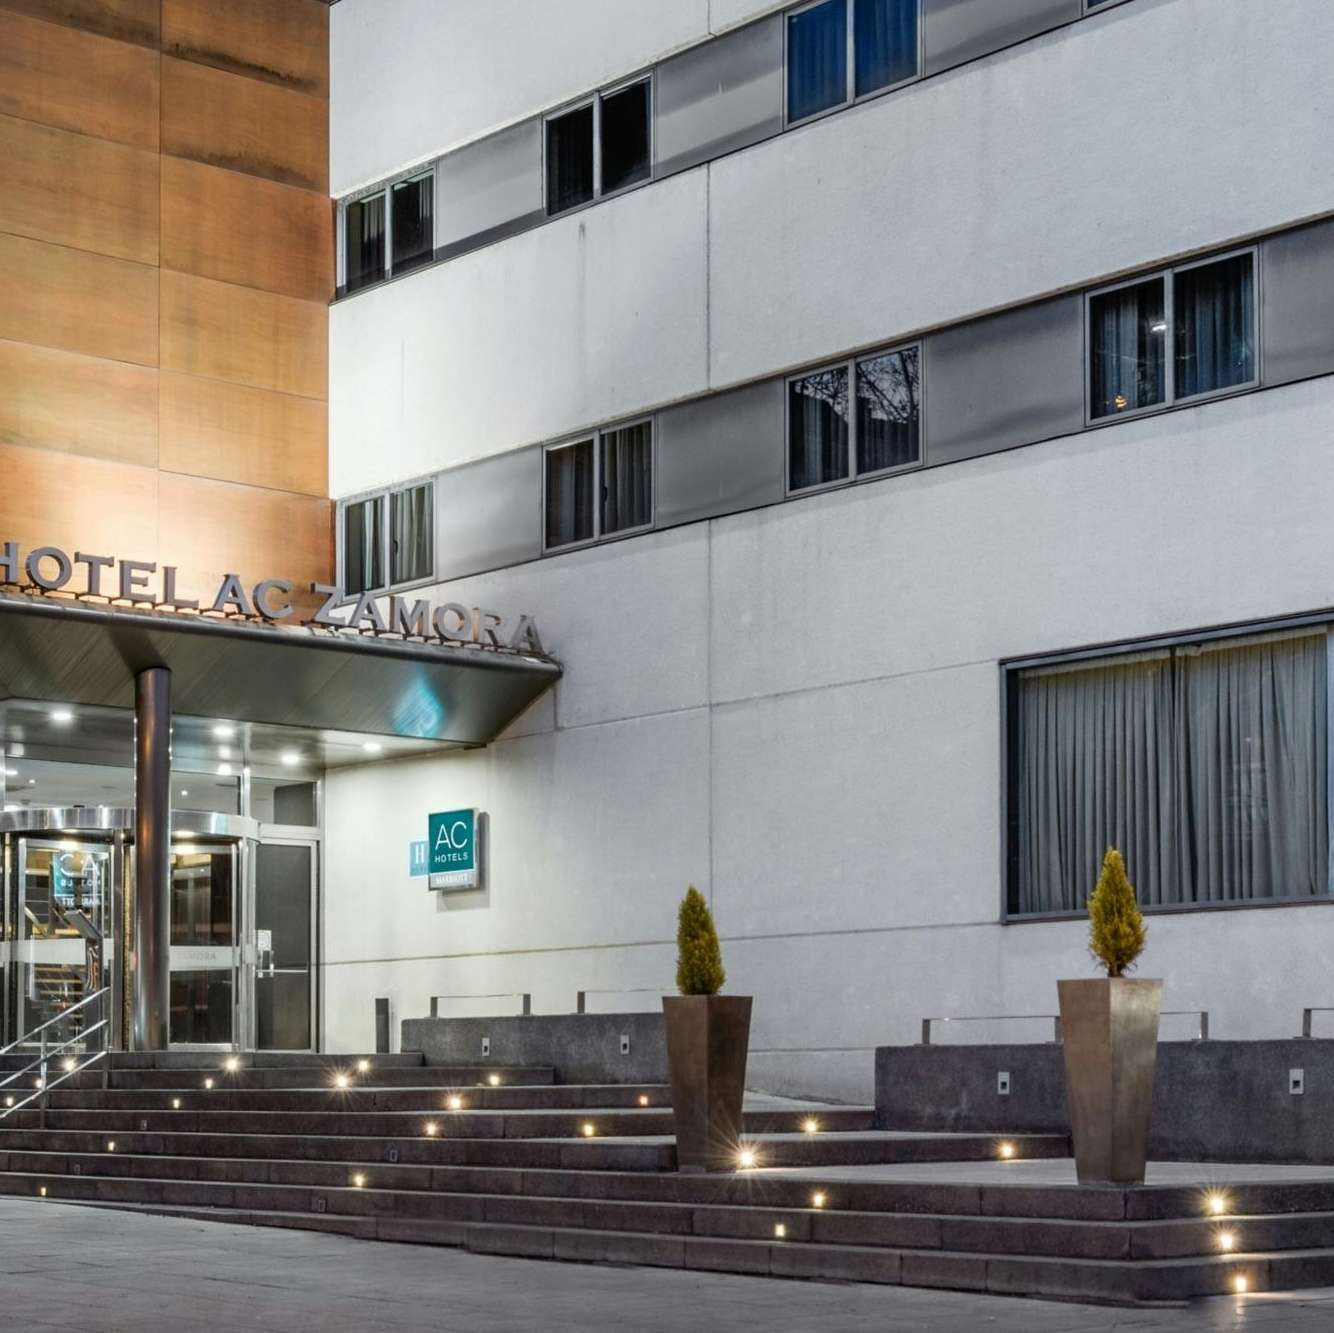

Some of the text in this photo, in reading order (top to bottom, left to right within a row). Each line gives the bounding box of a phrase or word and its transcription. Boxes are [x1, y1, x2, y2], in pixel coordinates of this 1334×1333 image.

[212, 573, 294, 620] AC
[310, 582, 545, 656] ZAMORA
[435, 821, 468, 851] AC
[415, 844, 425, 864] H
[434, 851, 469, 863] HOTELS
